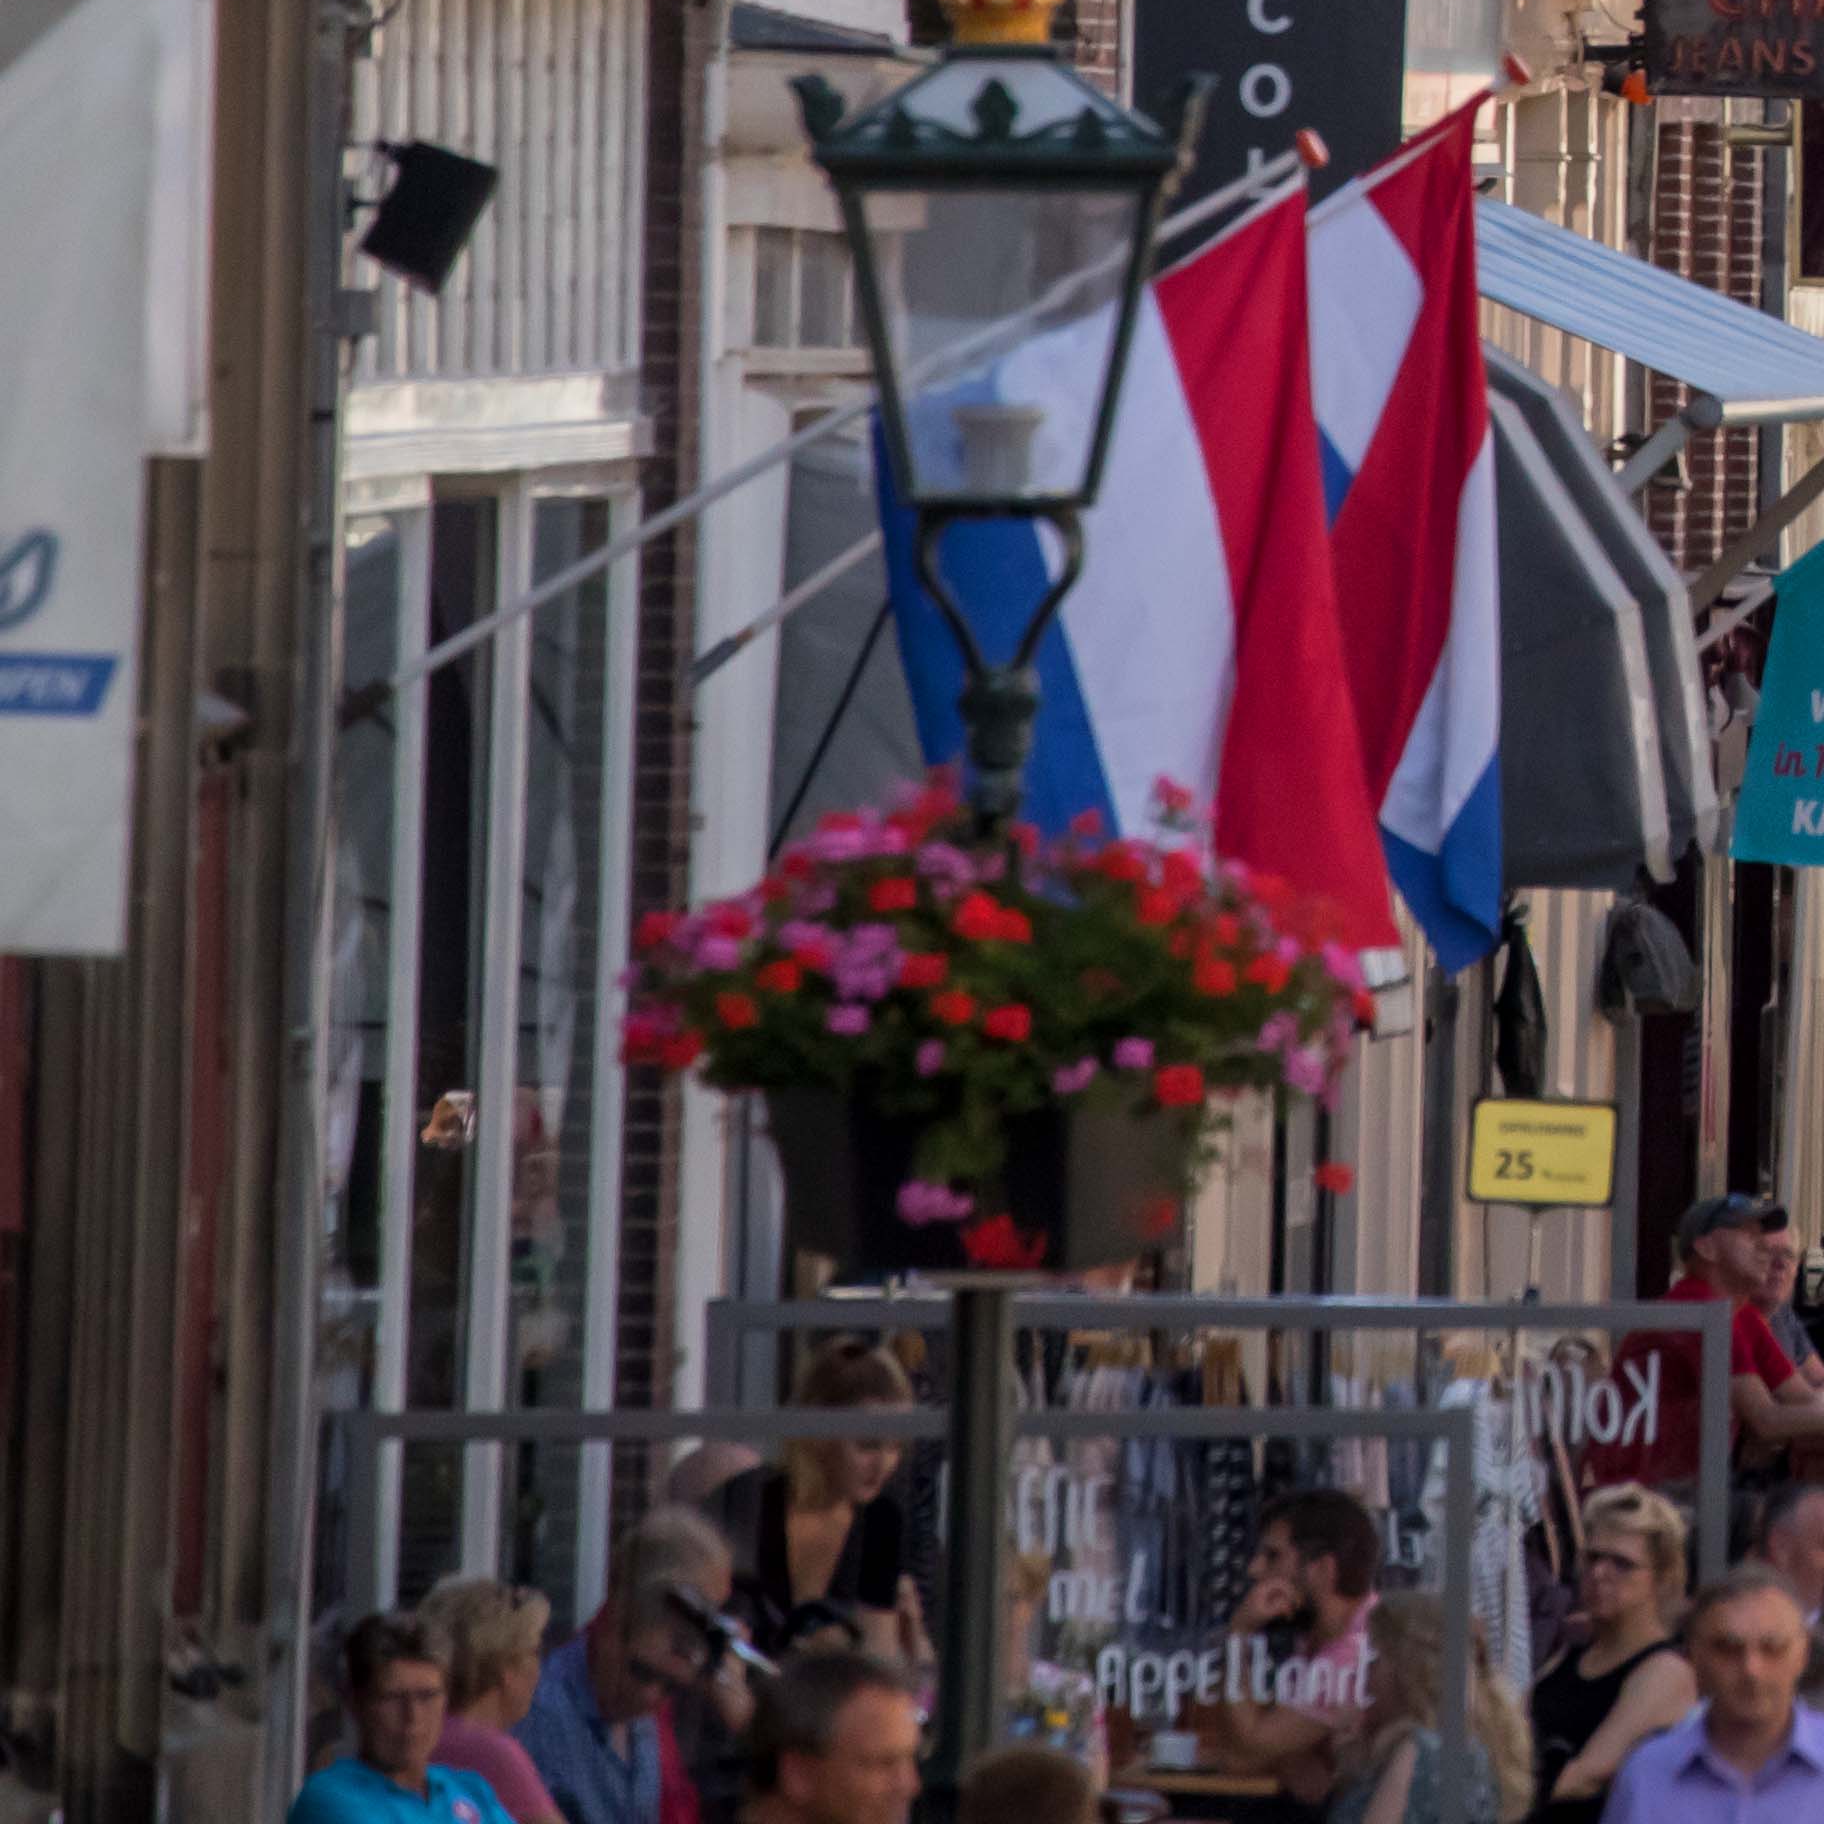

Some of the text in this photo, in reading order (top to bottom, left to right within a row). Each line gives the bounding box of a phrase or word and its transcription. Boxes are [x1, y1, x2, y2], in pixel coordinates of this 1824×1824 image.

[1669, 32, 1816, 76] JEANS
[1773, 741, 1806, 778] in
[1493, 1150, 1535, 1180] 25
